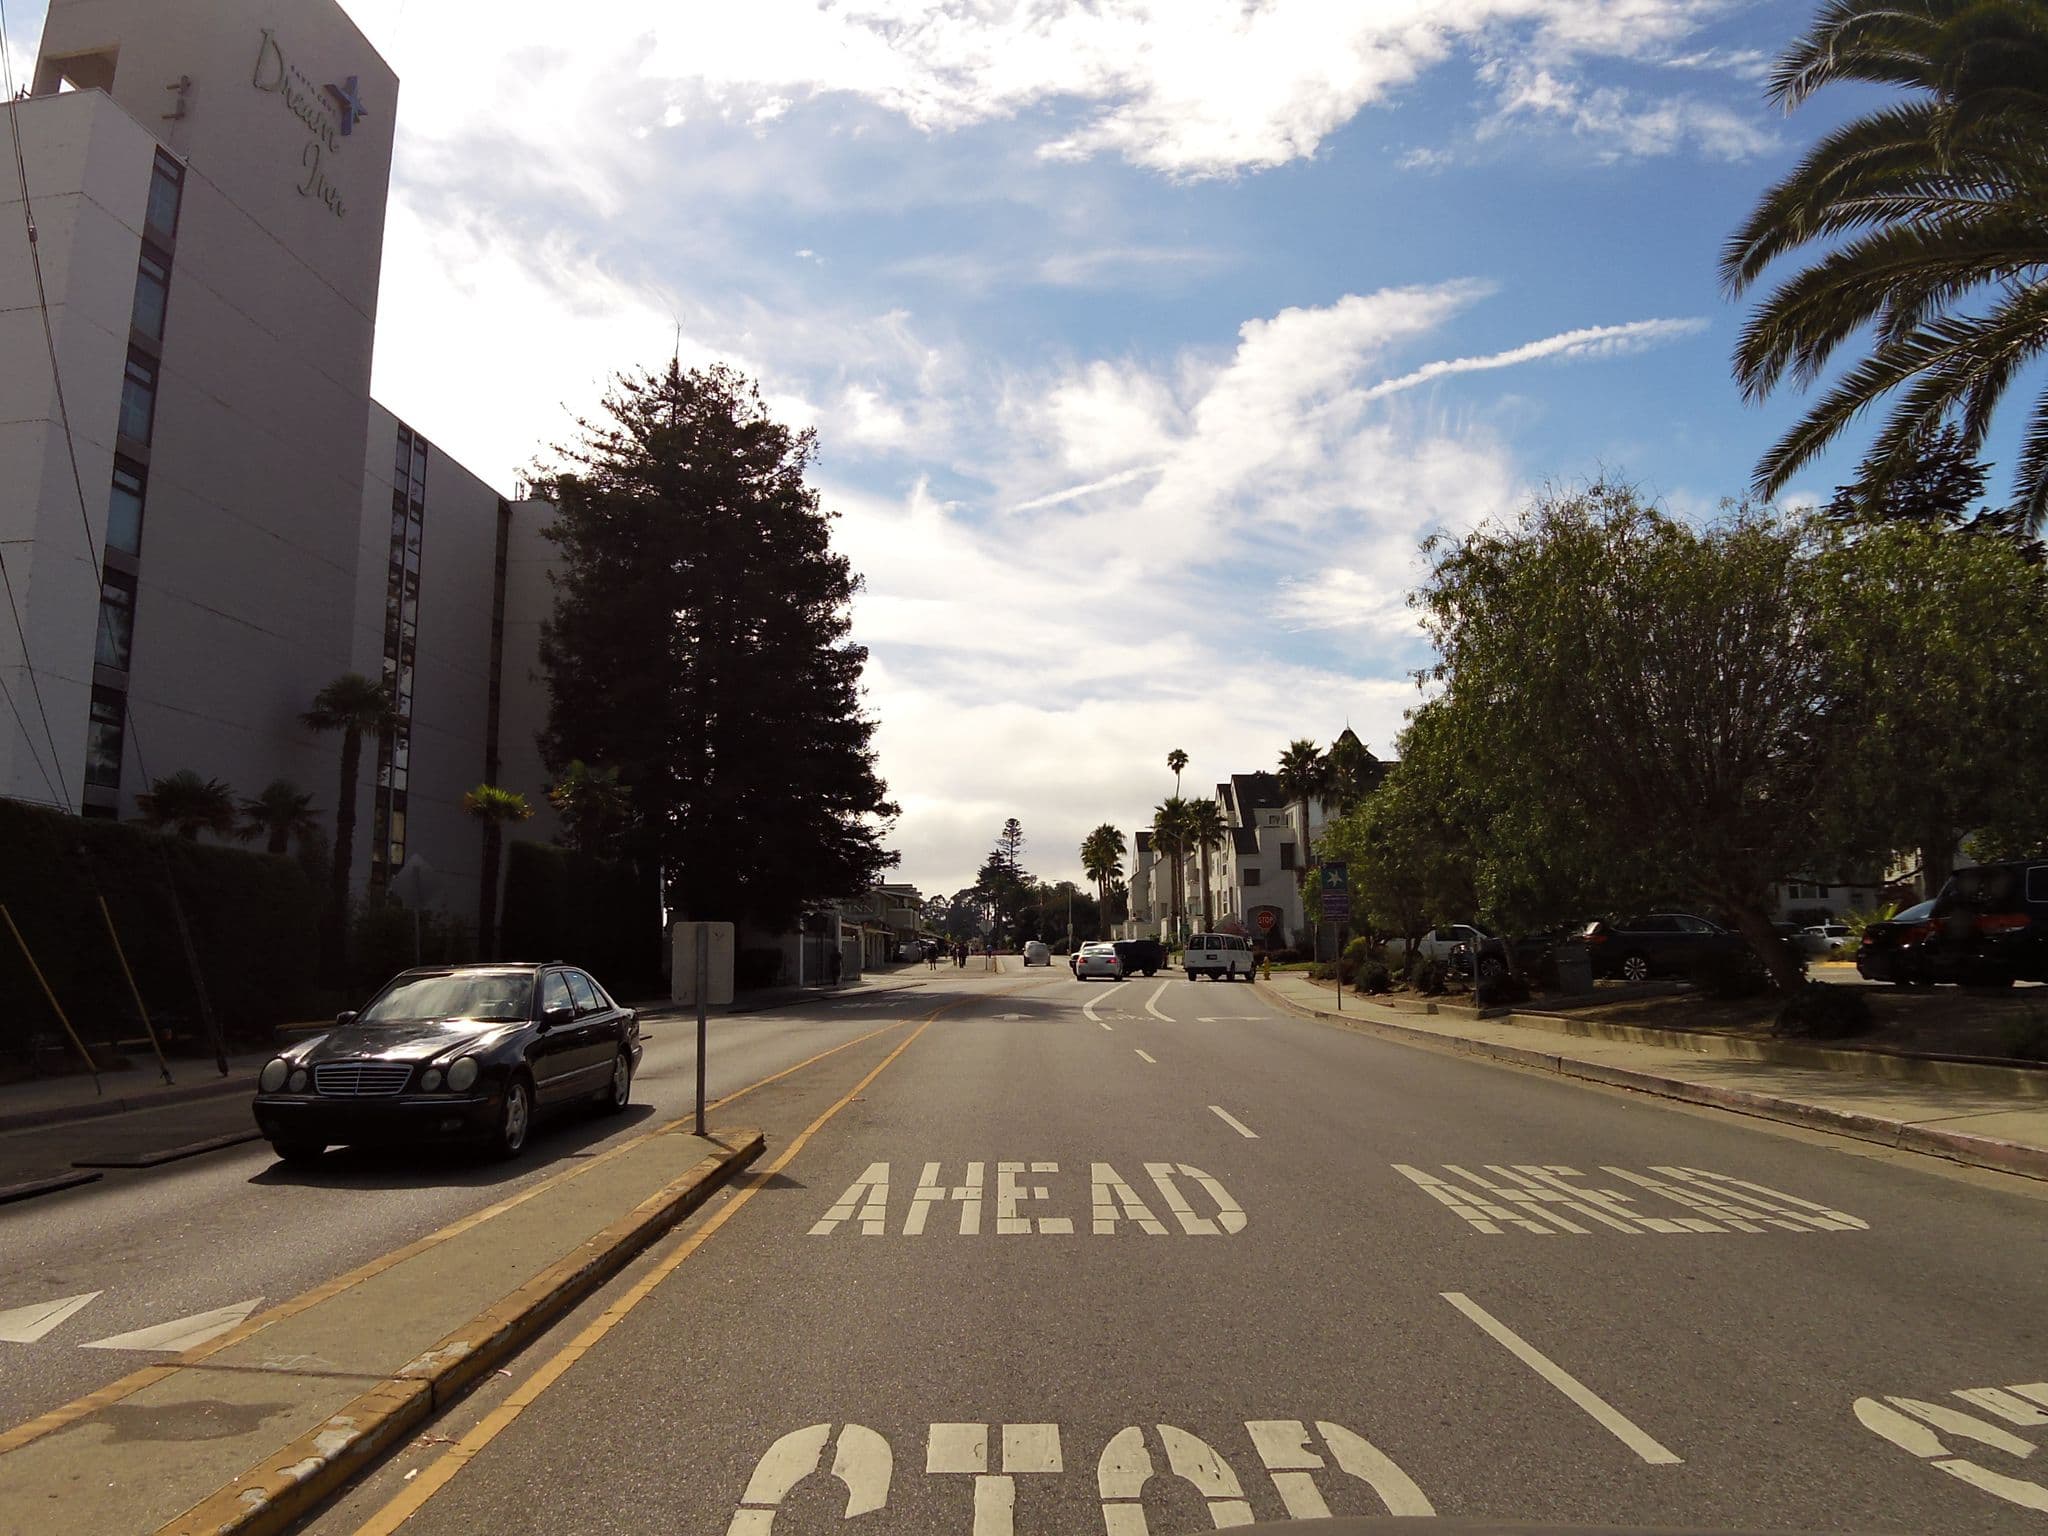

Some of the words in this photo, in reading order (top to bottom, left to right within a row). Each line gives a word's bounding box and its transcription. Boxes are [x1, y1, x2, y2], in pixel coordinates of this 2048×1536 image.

[253, 28, 340, 153] Dream
[1257, 916, 1274, 925] STOP
[806, 1162, 1248, 1235] AHEAD
[1390, 1164, 1870, 1234] AHEAD
